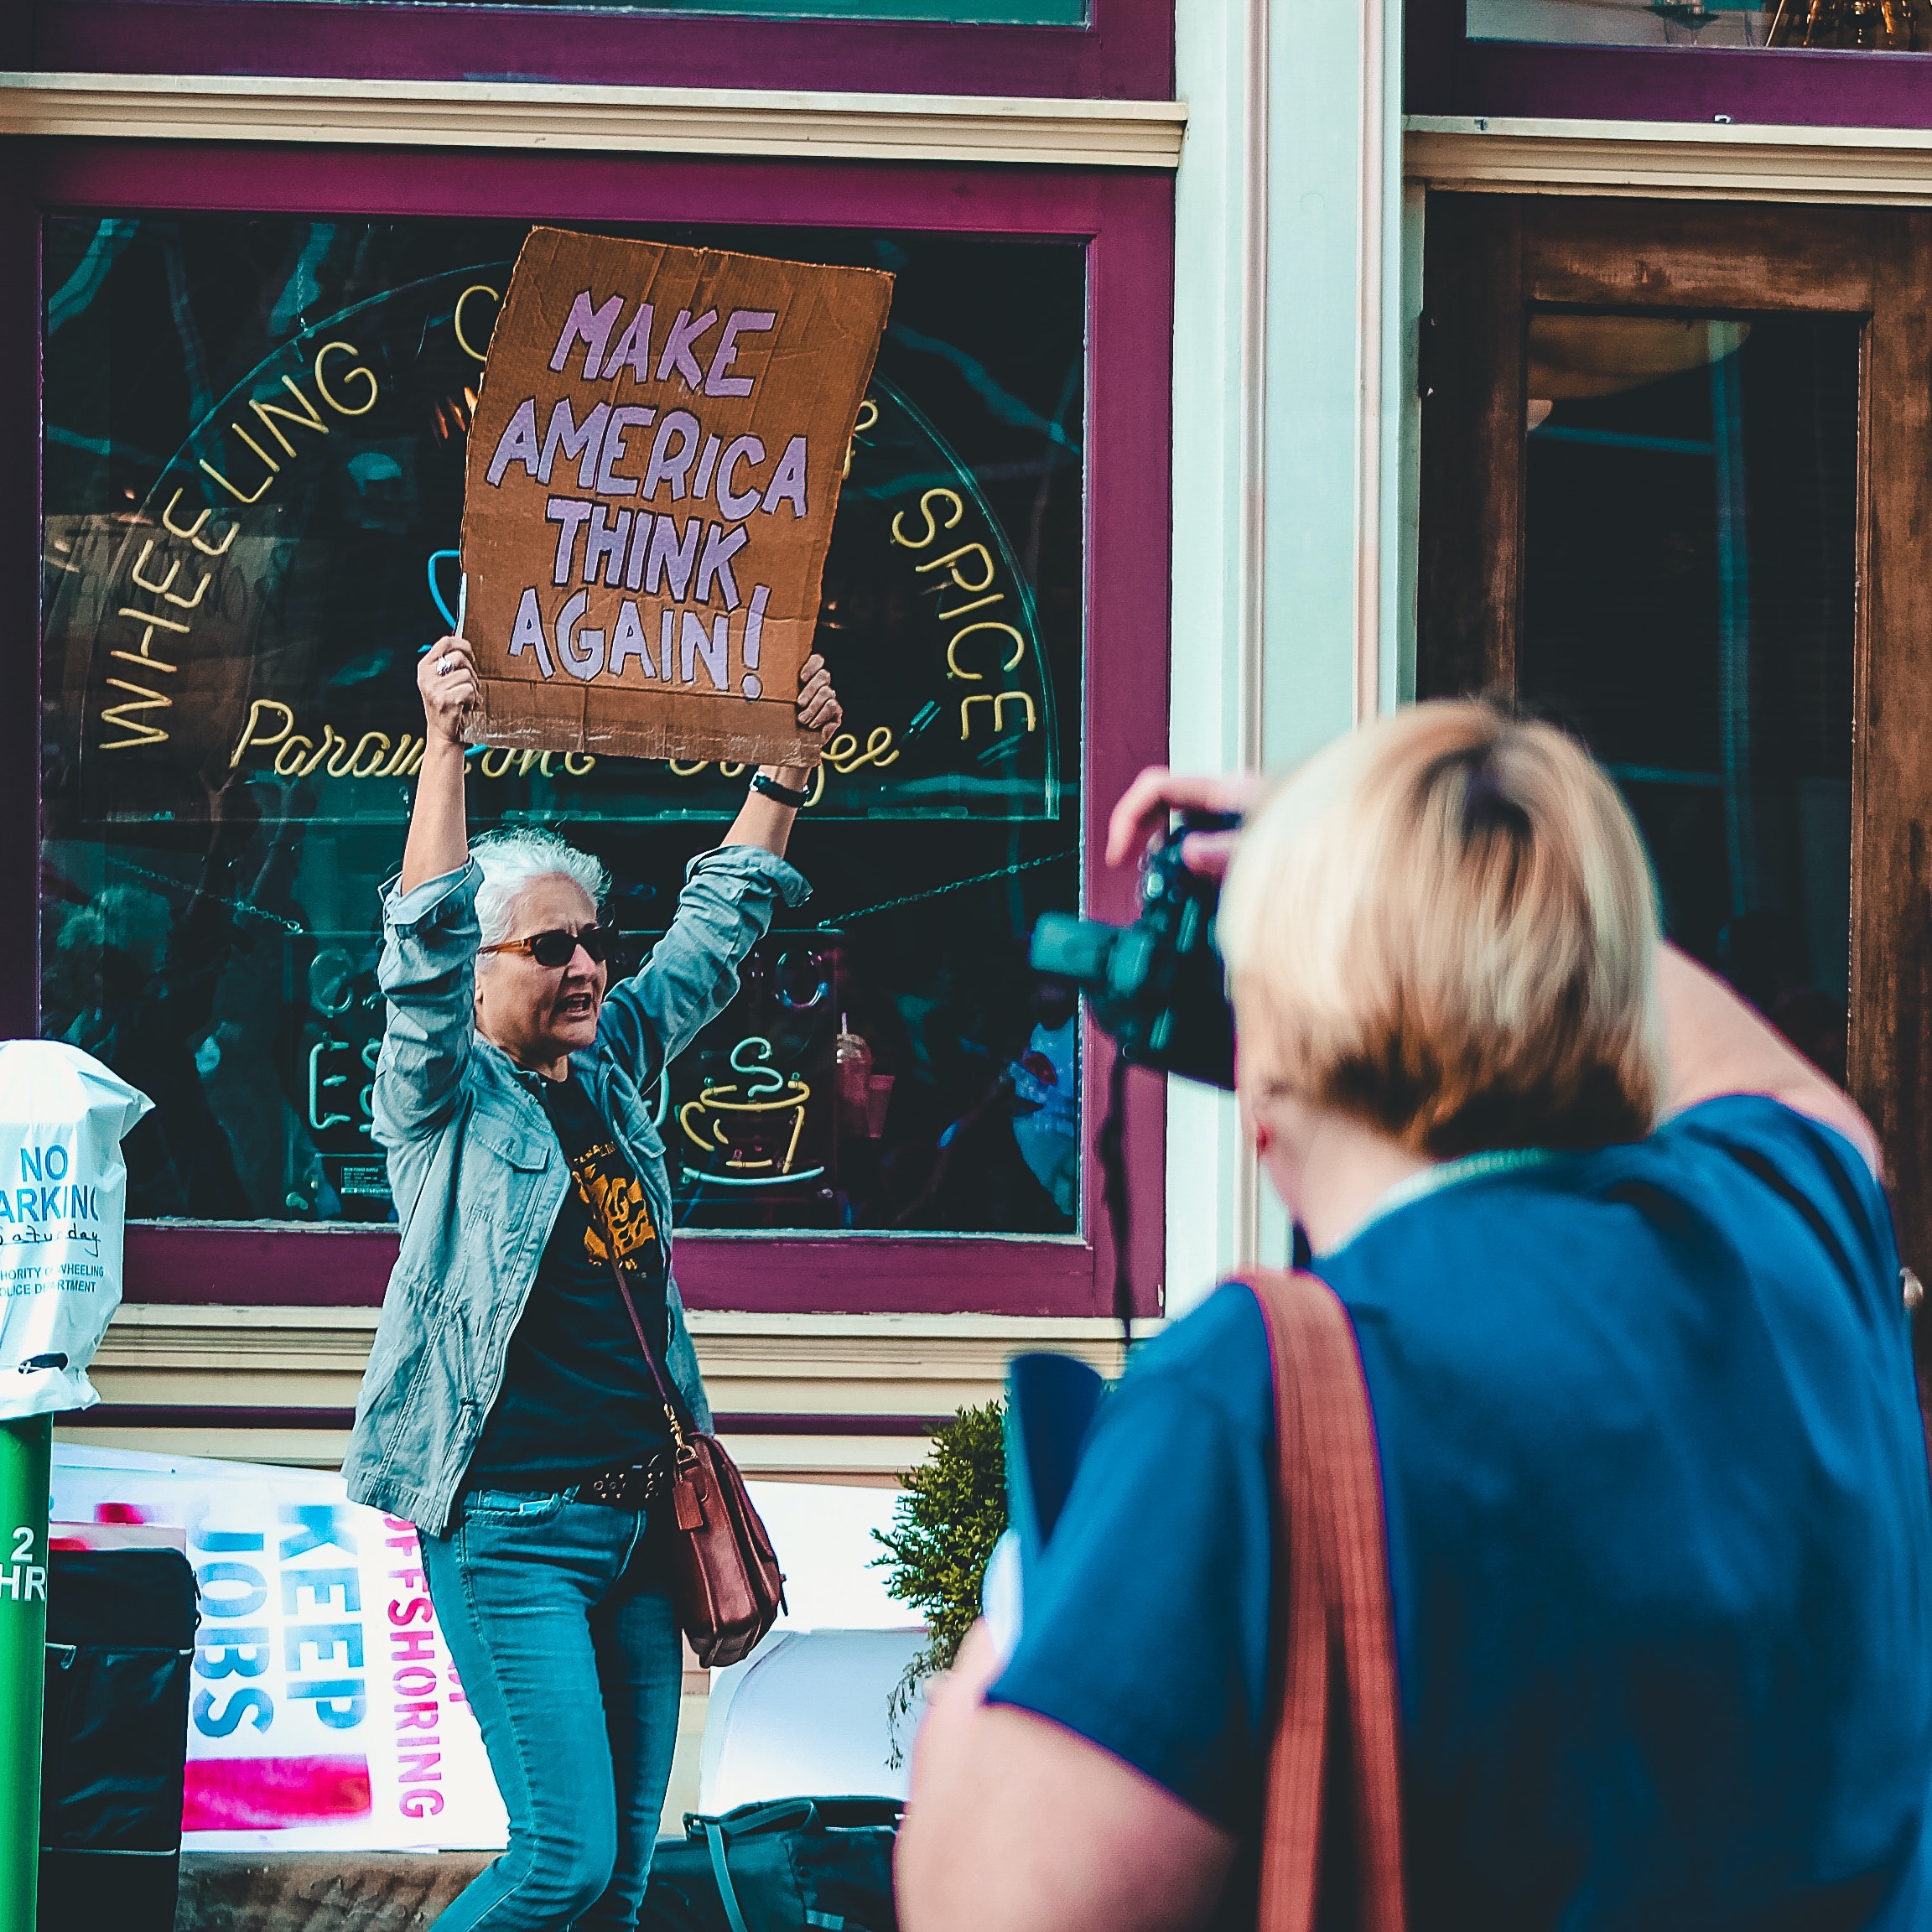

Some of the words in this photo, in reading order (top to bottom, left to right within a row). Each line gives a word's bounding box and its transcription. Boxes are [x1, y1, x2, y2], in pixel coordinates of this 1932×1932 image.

[548, 288, 776, 397] MAKE
[486, 397, 809, 522] AMERICA
[99, 341, 378, 749] WHEELING
[891, 488, 1036, 740] SPICE
[546, 496, 750, 612] THINK
[508, 584, 771, 701] AGAIN!
[20, 1145, 69, 1183] NO
[0, 1222, 99, 1258] aturday
[0, 1267, 41, 1281] HORITY
[60, 1263, 105, 1278] WHEELING
[34, 1280, 96, 1294] DARTMENT
[0, 1563, 47, 1602] HR
[11, 1526, 34, 1563] 2
[191, 1509, 274, 1738] JOBS
[278, 1504, 368, 1729] KEEP
